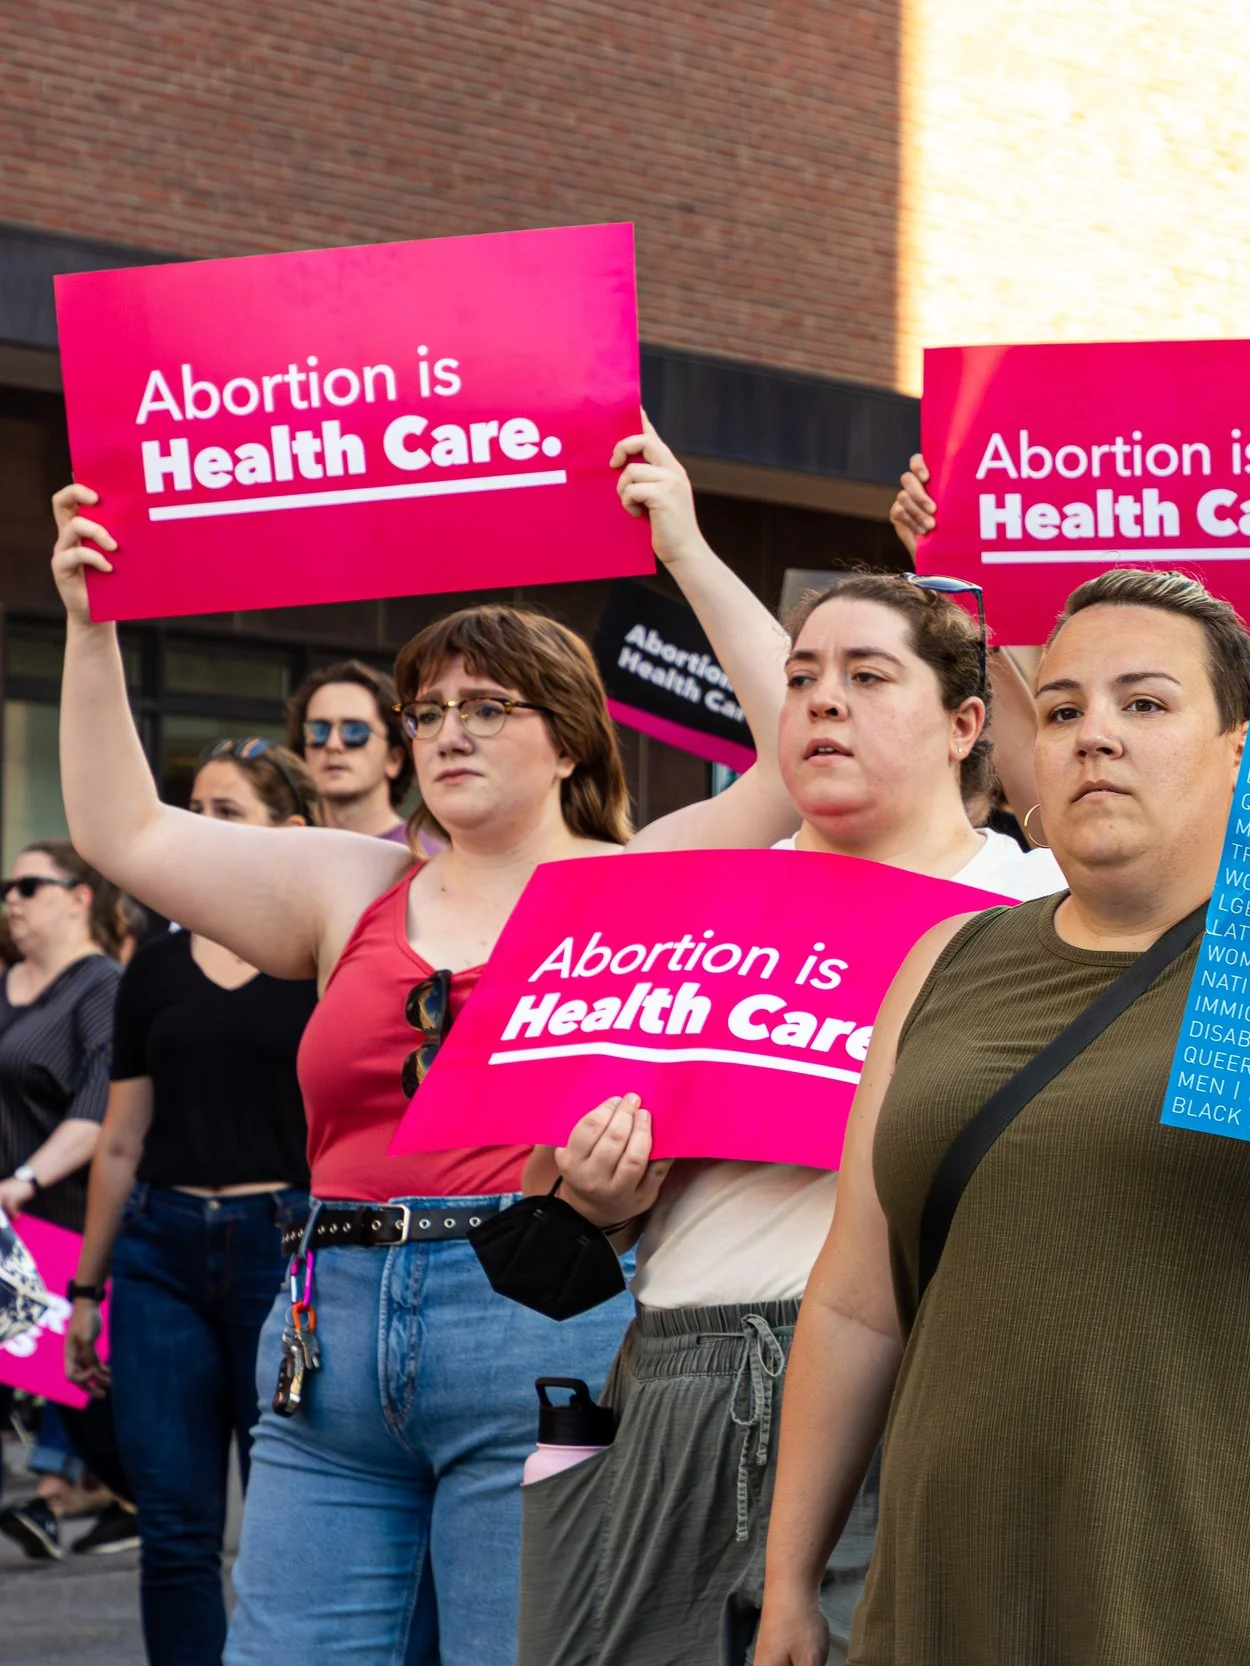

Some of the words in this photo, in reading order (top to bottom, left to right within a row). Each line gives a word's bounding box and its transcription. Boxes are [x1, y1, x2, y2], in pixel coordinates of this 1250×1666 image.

[136, 356, 396, 424] Abortion
[417, 345, 461, 397] is
[141, 420, 365, 494] Health
[383, 414, 562, 471] Care.
[976, 429, 1211, 480] Abortion
[979, 488, 1180, 540] Health
[617, 647, 701, 704] Health
[704, 690, 744, 722] Car
[528, 929, 779, 982] Abortion
[796, 942, 849, 990] is
[501, 982, 711, 1041] Health
[727, 993, 874, 1062] Care
[1172, 1096, 1241, 1125] BLACK
[1178, 1071, 1225, 1095] MEN
